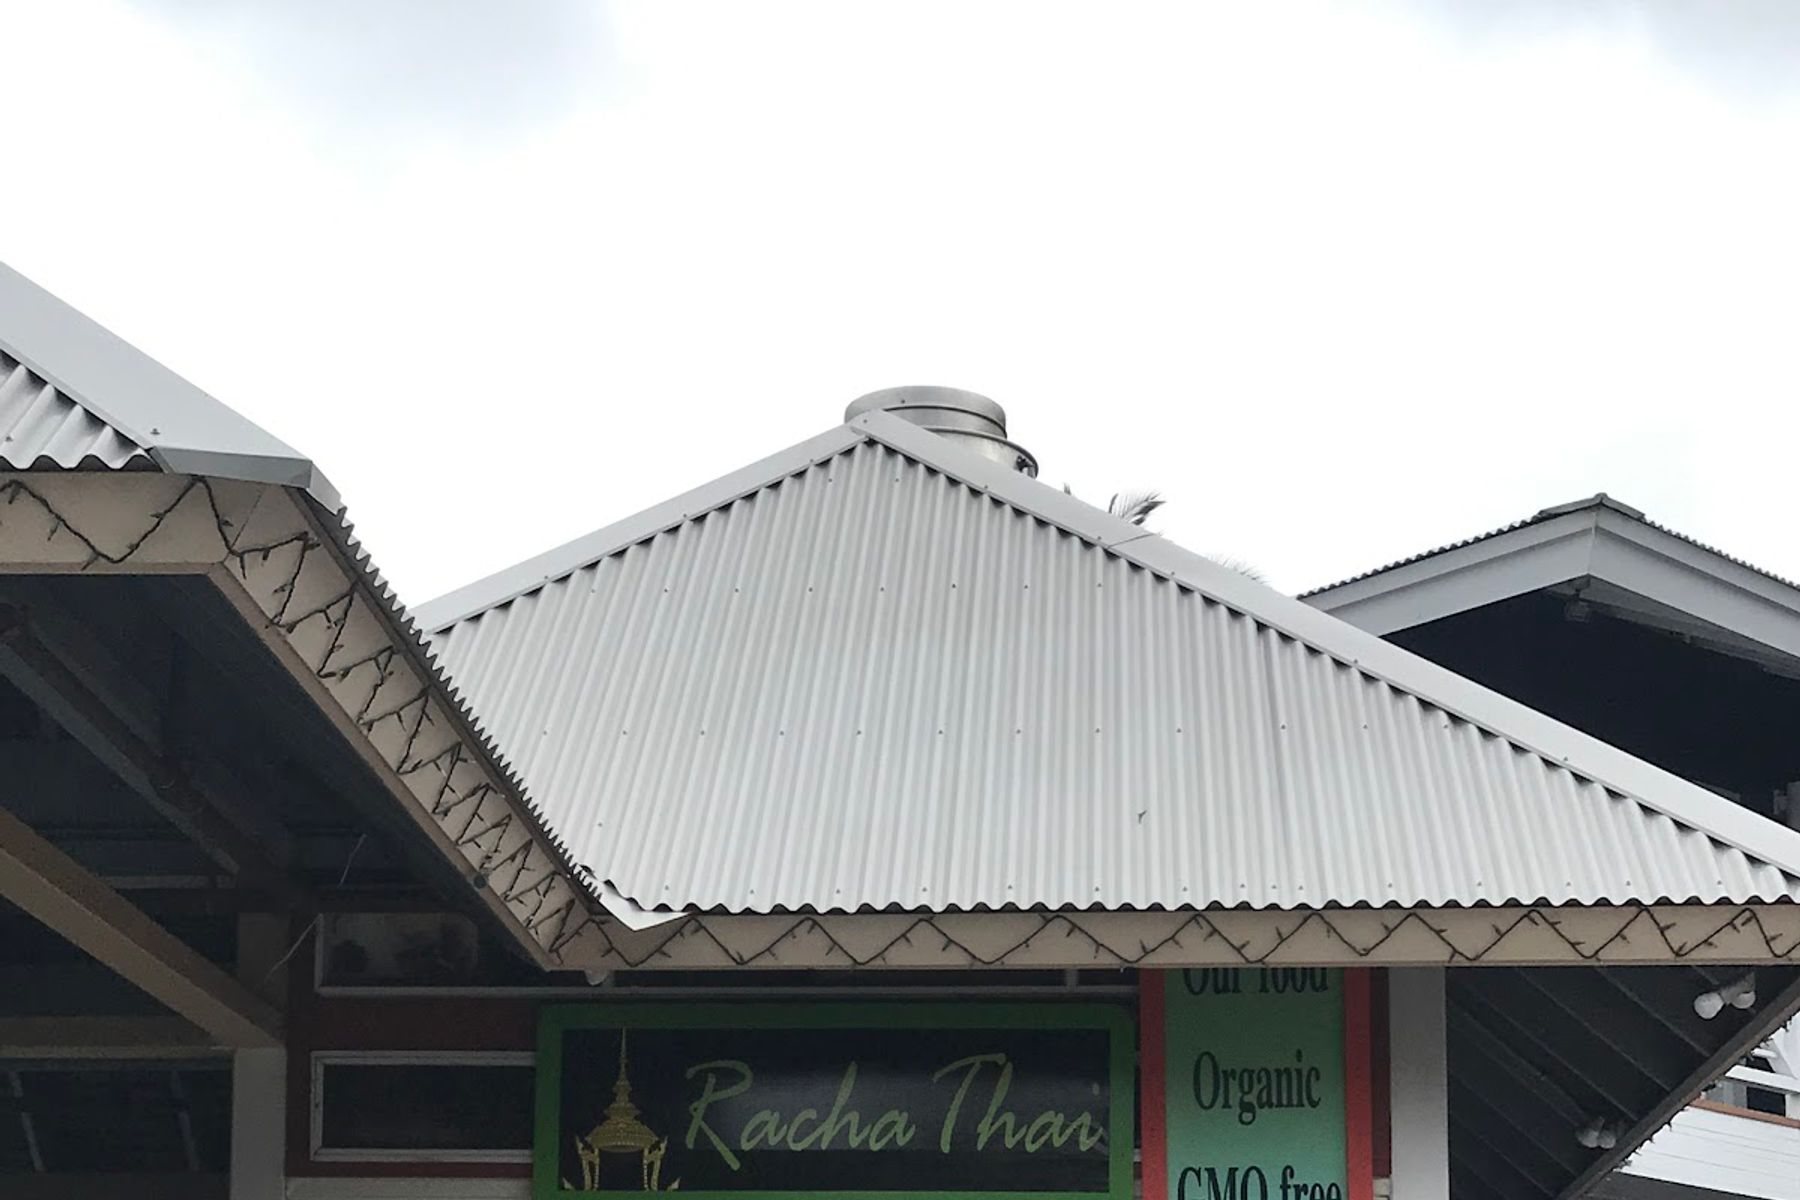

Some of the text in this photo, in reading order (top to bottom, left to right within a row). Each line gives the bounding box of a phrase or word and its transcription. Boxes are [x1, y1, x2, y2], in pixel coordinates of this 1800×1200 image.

[685, 1052, 1106, 1171] Racha Thai
[1193, 1049, 1322, 1125] Organic
